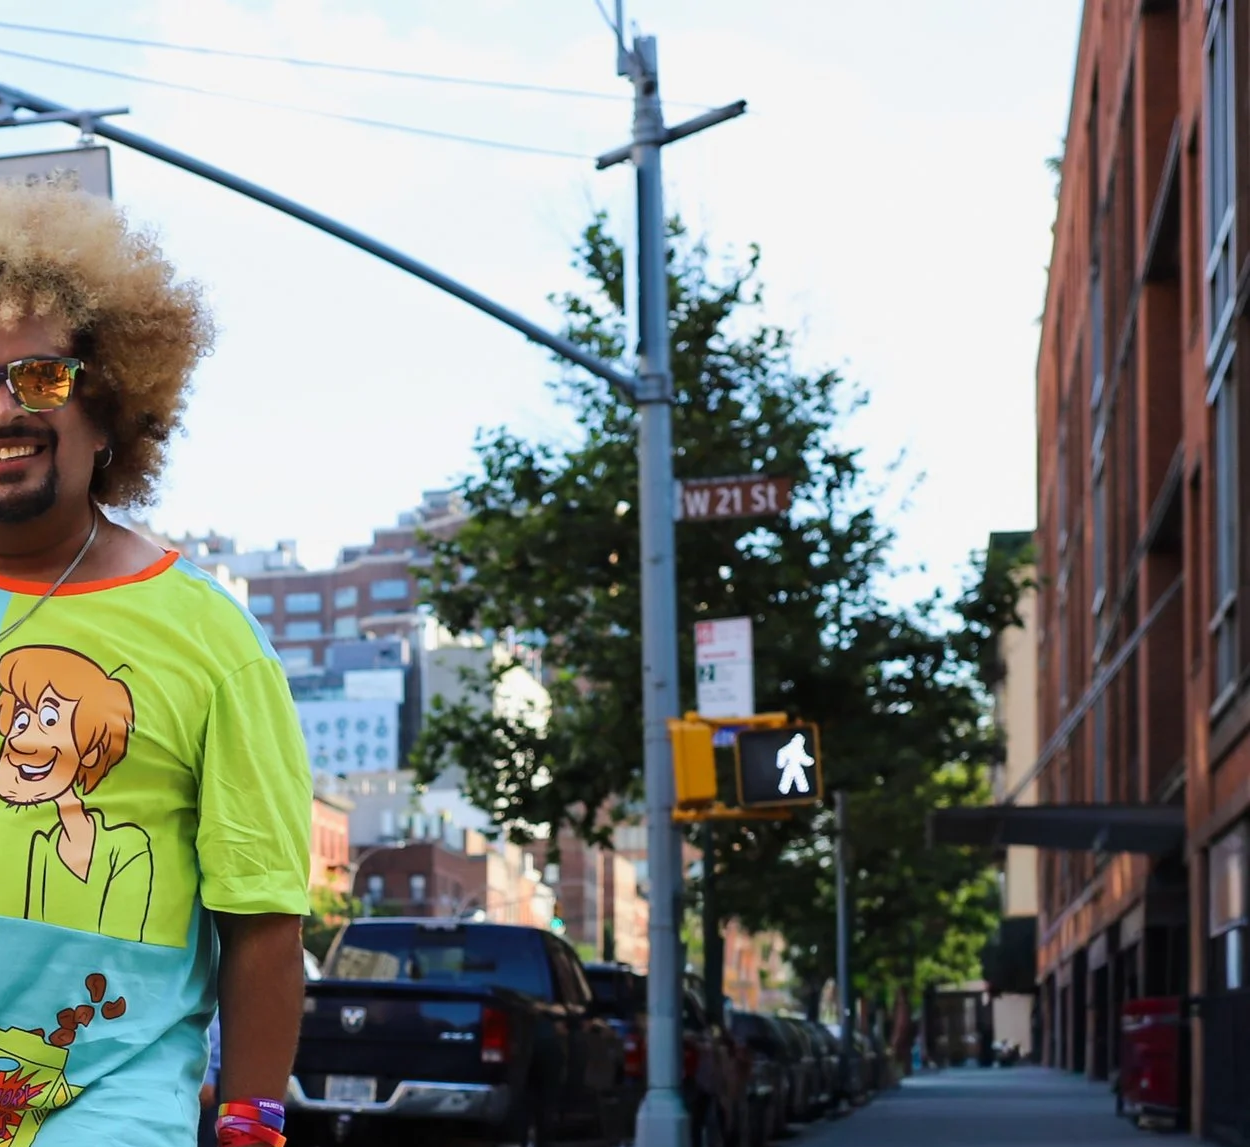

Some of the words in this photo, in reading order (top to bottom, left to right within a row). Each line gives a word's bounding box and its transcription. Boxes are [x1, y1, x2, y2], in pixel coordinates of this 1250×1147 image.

[685, 488, 710, 517] W
[715, 486, 742, 516] 21
[751, 482, 778, 513] St
